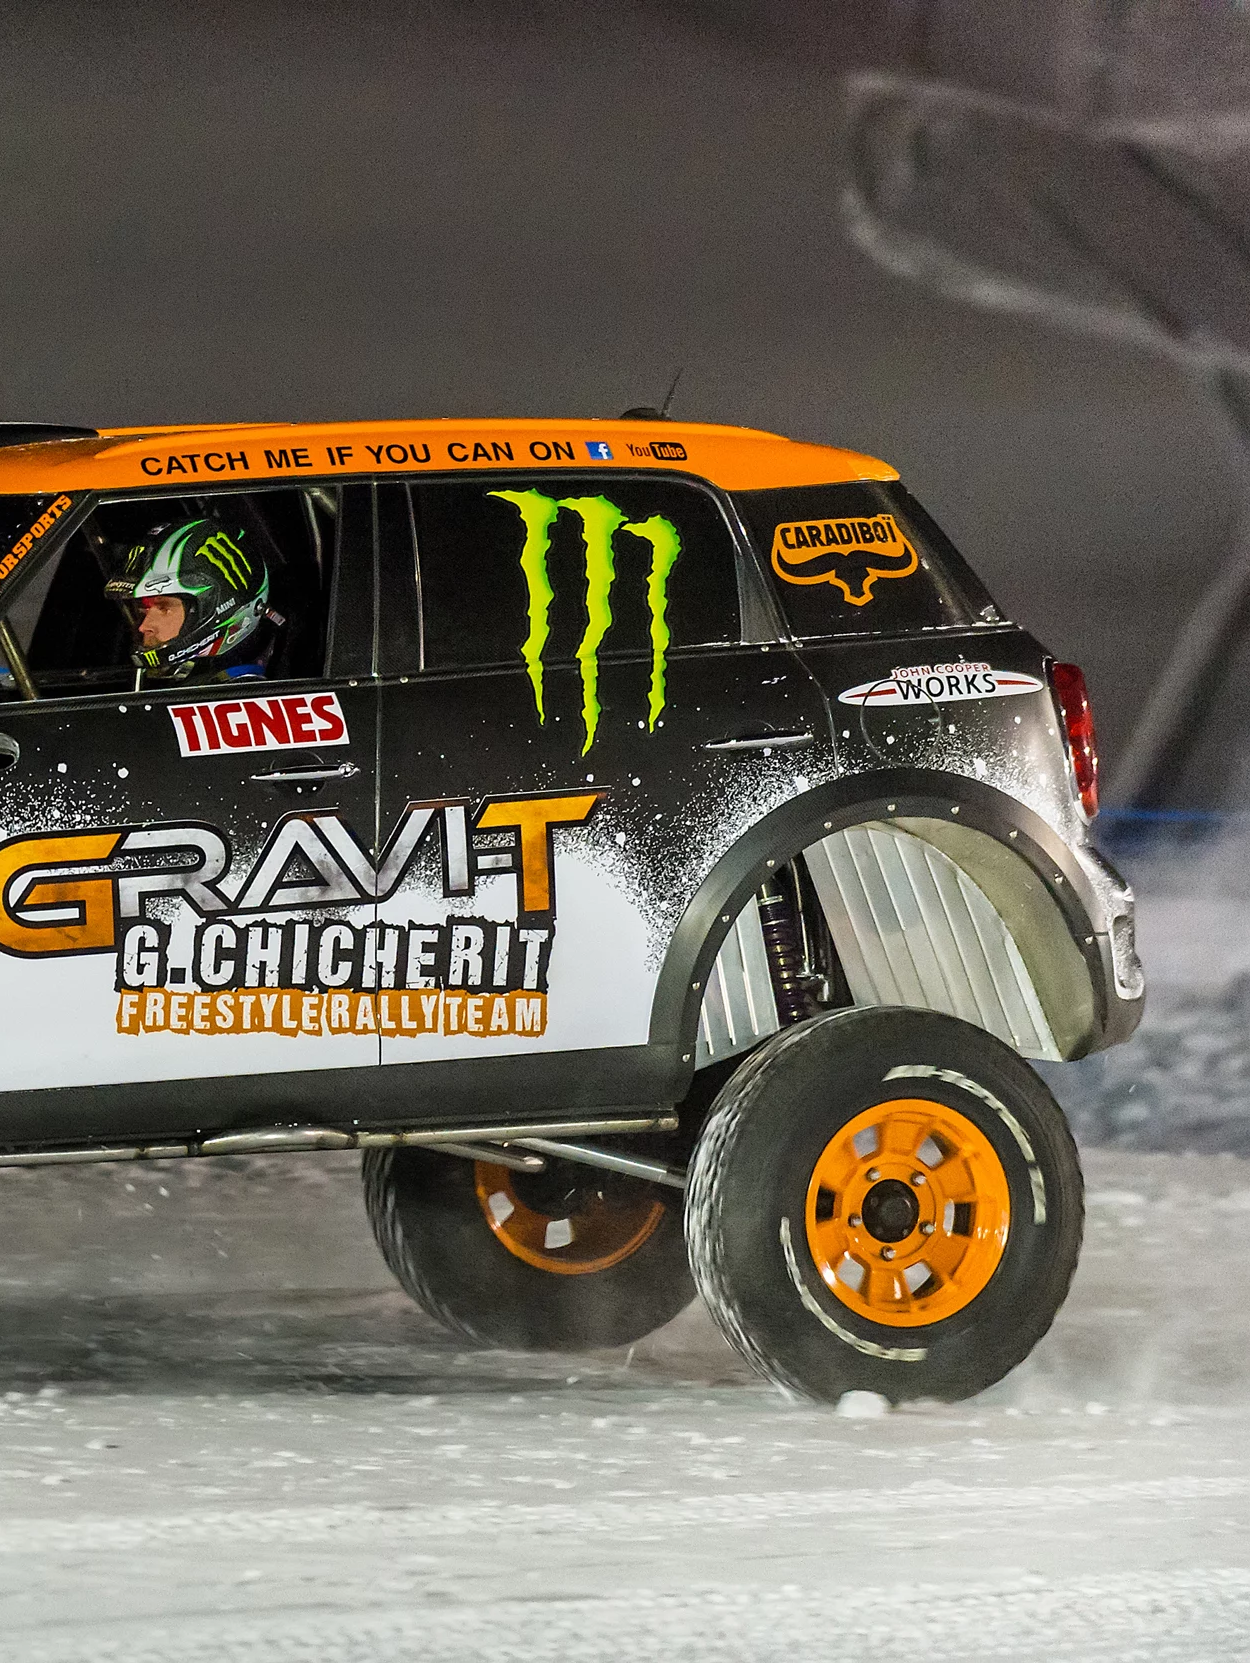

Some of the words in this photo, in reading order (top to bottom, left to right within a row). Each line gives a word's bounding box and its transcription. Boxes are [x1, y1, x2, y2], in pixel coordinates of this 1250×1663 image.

[140, 451, 249, 477] CATCH
[264, 447, 312, 470] ME
[327, 445, 354, 467] IF
[365, 443, 431, 464] YOU
[447, 441, 513, 464] CAN
[529, 441, 576, 462] ON
[626, 443, 686, 459] YouTube
[215, 597, 236, 616] MINI
[893, 666, 931, 680] JOHN
[935, 663, 990, 674] COOPER
[896, 674, 996, 700] WORKS
[174, 696, 344, 752] TIGNES
[122, 923, 549, 990] G.CHICHERIT
[121, 992, 319, 1030] FREESTYLE
[330, 994, 438, 1030] RALLY
[445, 996, 542, 1032] TEAM
